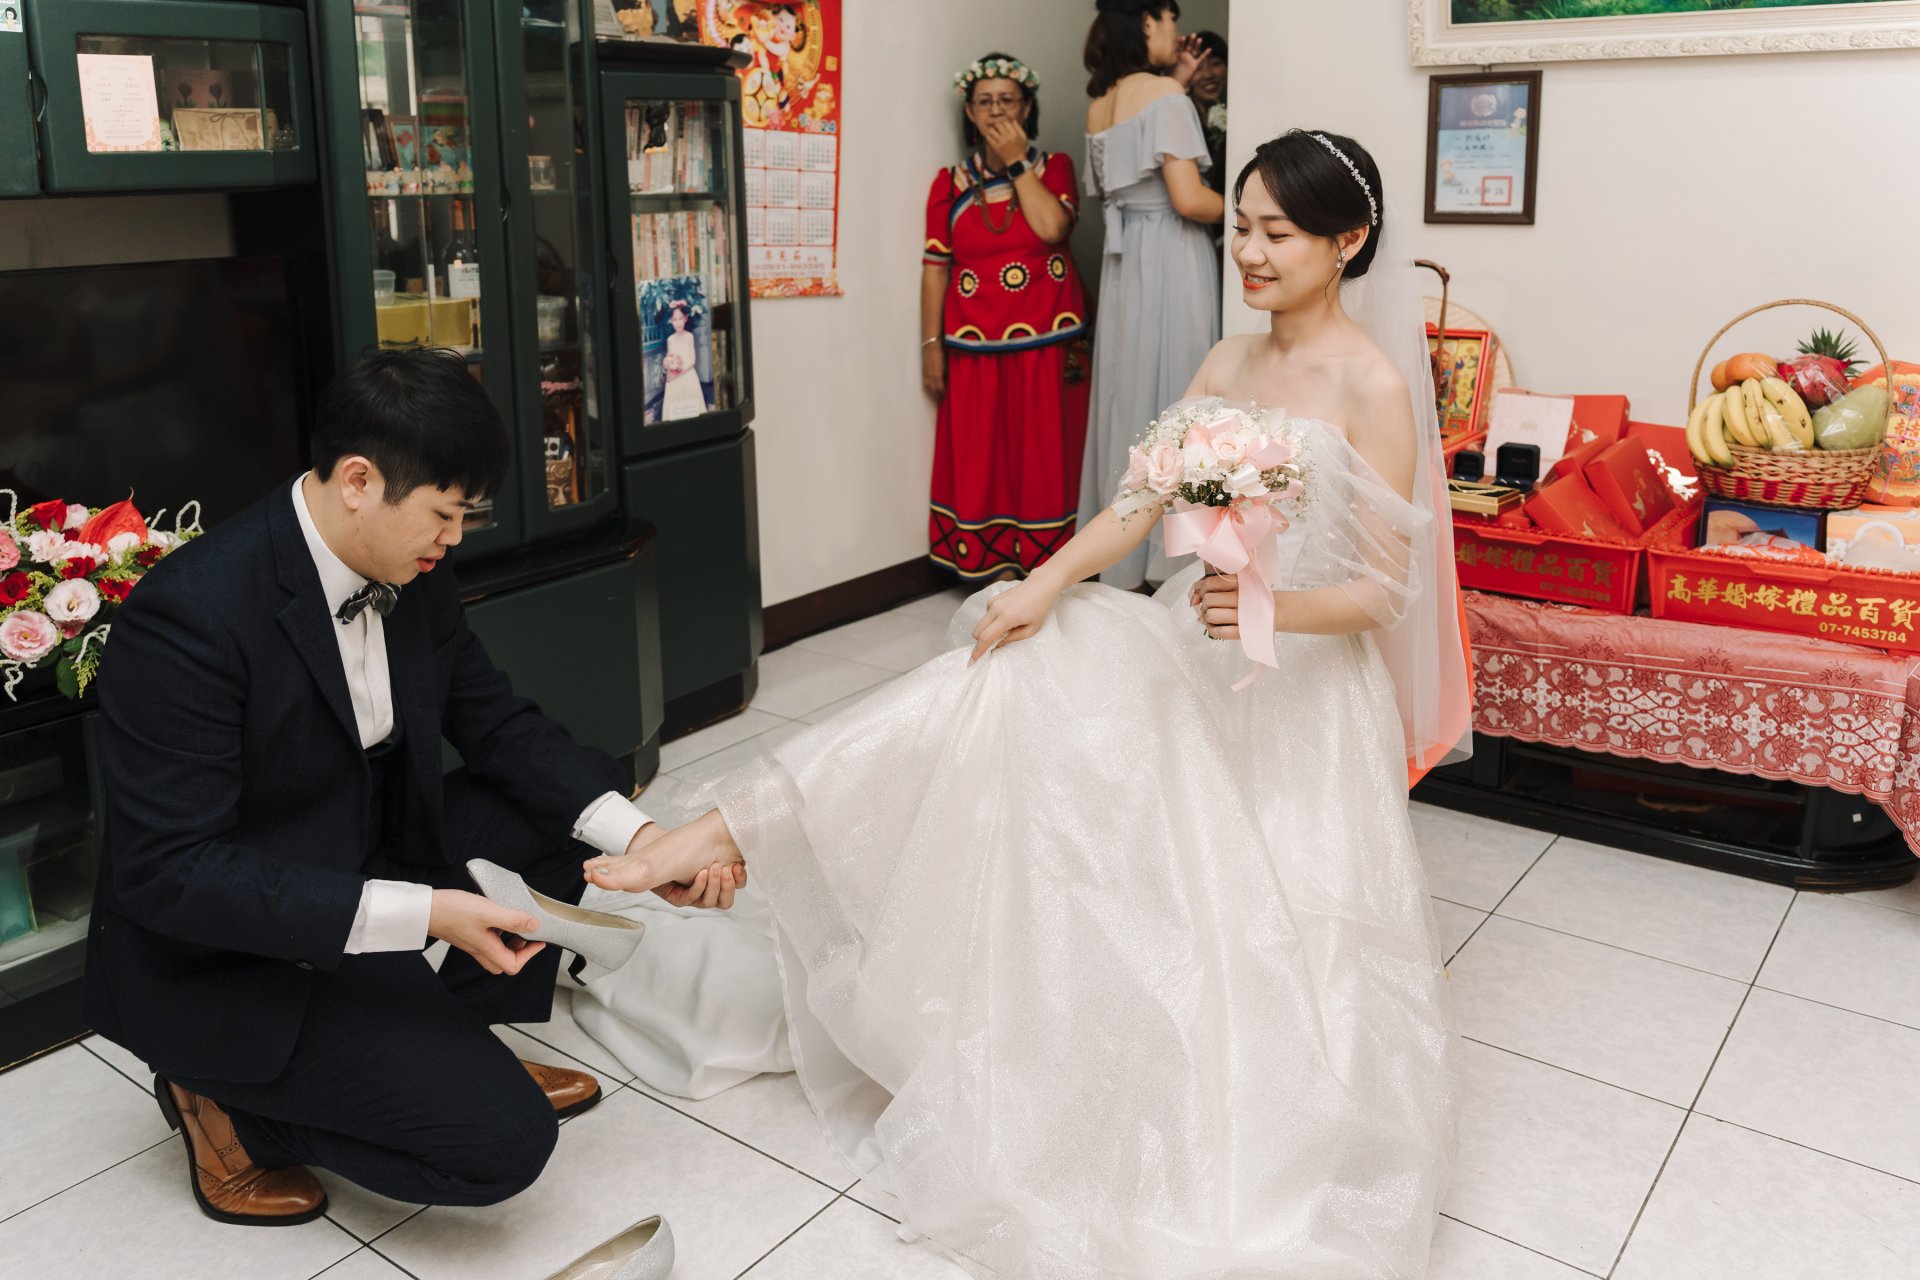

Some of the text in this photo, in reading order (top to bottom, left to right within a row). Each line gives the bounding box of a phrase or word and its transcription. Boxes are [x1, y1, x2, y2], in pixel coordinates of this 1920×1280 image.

[1667, 574, 1920, 631] 高華婚嫁禮品百貨
[1819, 622, 1907, 643] 07-7453784
